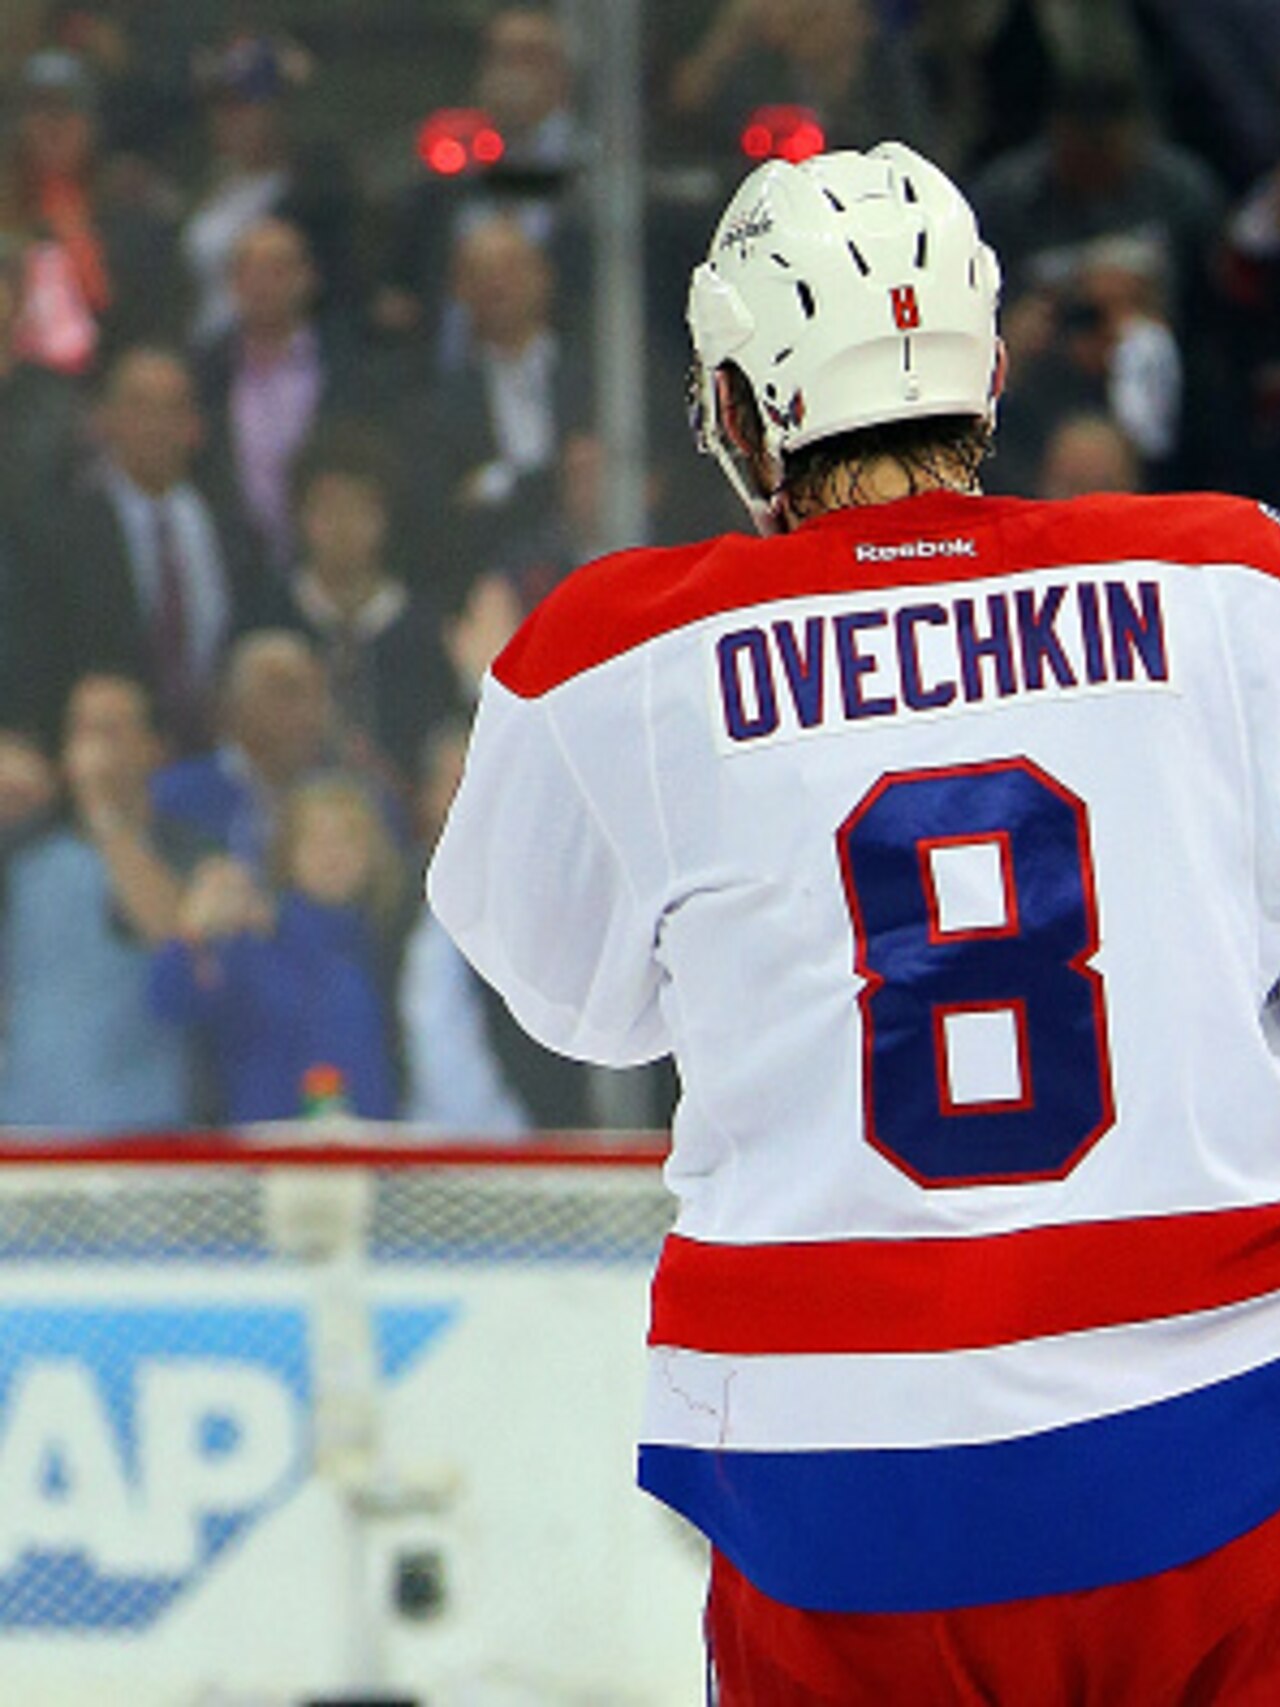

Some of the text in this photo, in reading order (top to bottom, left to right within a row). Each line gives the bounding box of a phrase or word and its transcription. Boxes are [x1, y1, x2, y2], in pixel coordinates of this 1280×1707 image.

[889, 285, 919, 330] 8
[856, 537, 977, 561] Reebok
[716, 581, 1169, 742] OVECHKIN
[835, 755, 1117, 1190] 8
